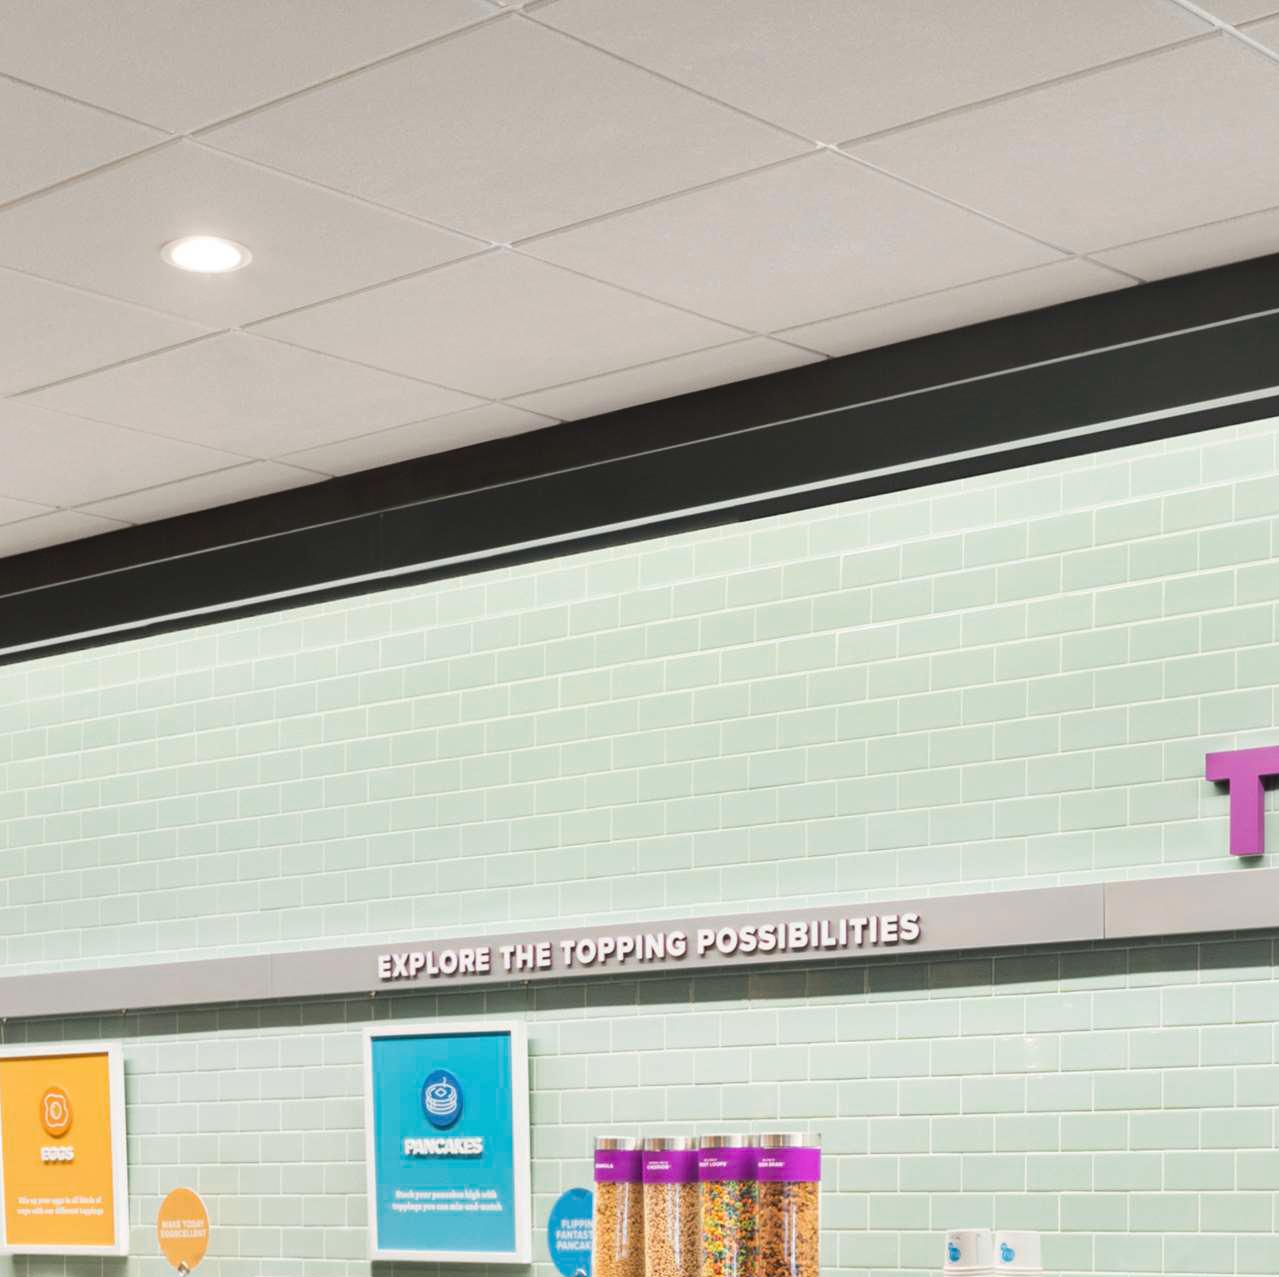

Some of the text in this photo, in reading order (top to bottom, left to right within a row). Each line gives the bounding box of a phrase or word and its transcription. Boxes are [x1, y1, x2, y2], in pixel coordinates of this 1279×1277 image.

[377, 913, 921, 981] EXPLORE THE TOPPING POSSIBILITIES
[40, 1146, 75, 1162] EGGS
[404, 1137, 483, 1156] PANCAKES
